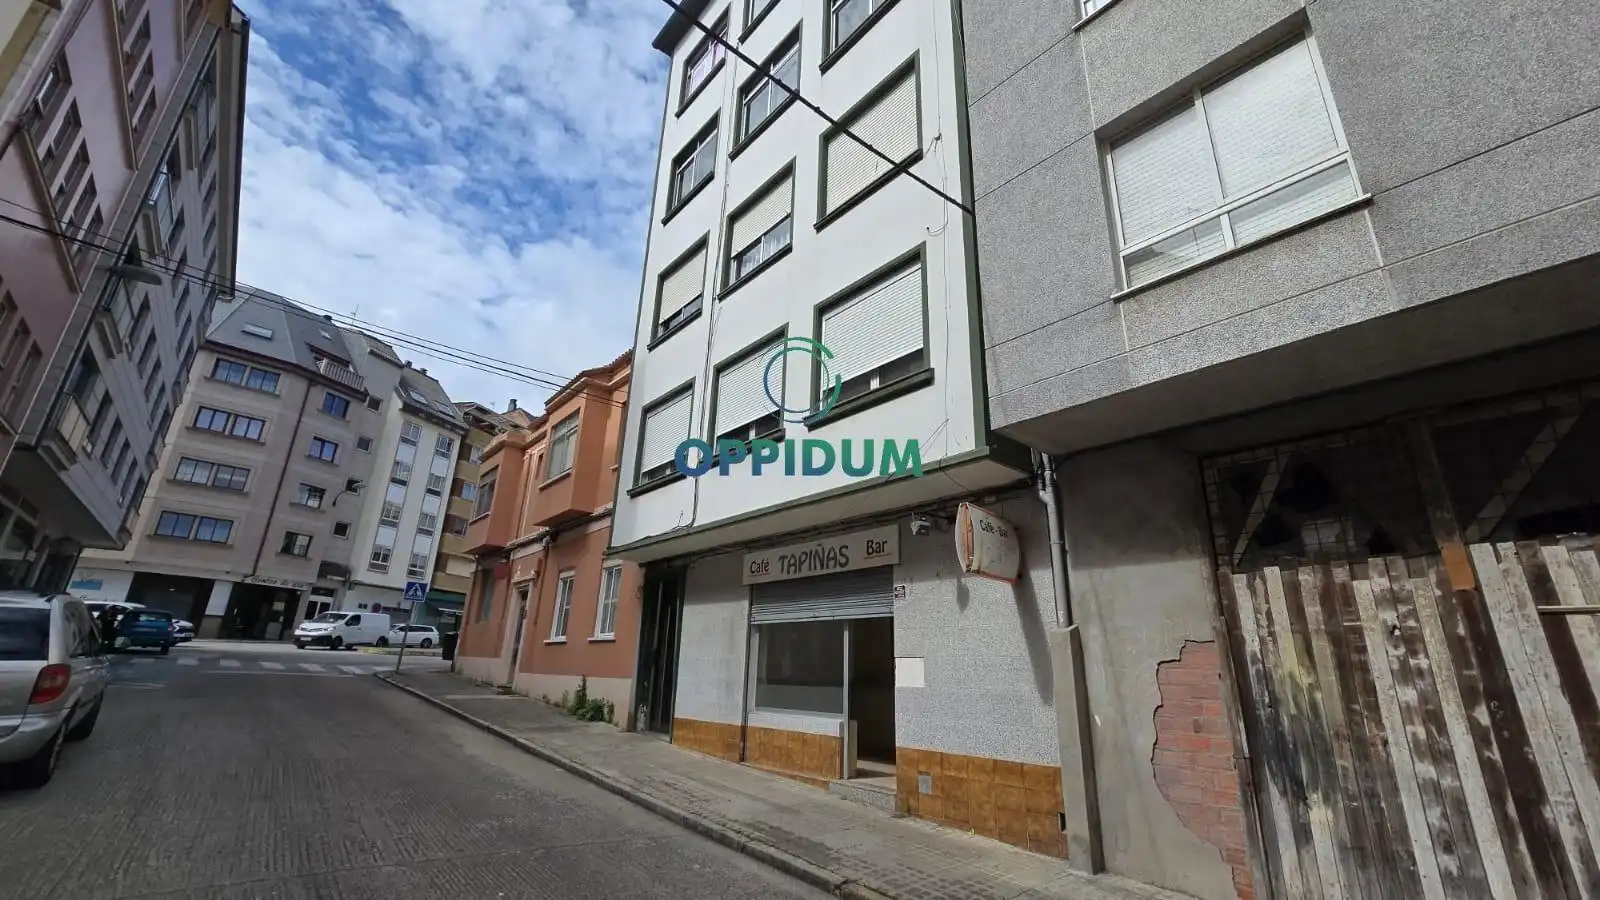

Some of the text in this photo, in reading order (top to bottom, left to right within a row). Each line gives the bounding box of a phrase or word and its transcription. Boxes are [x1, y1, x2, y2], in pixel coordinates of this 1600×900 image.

[750, 539, 888, 575] Café TAPIÑAS Bar
